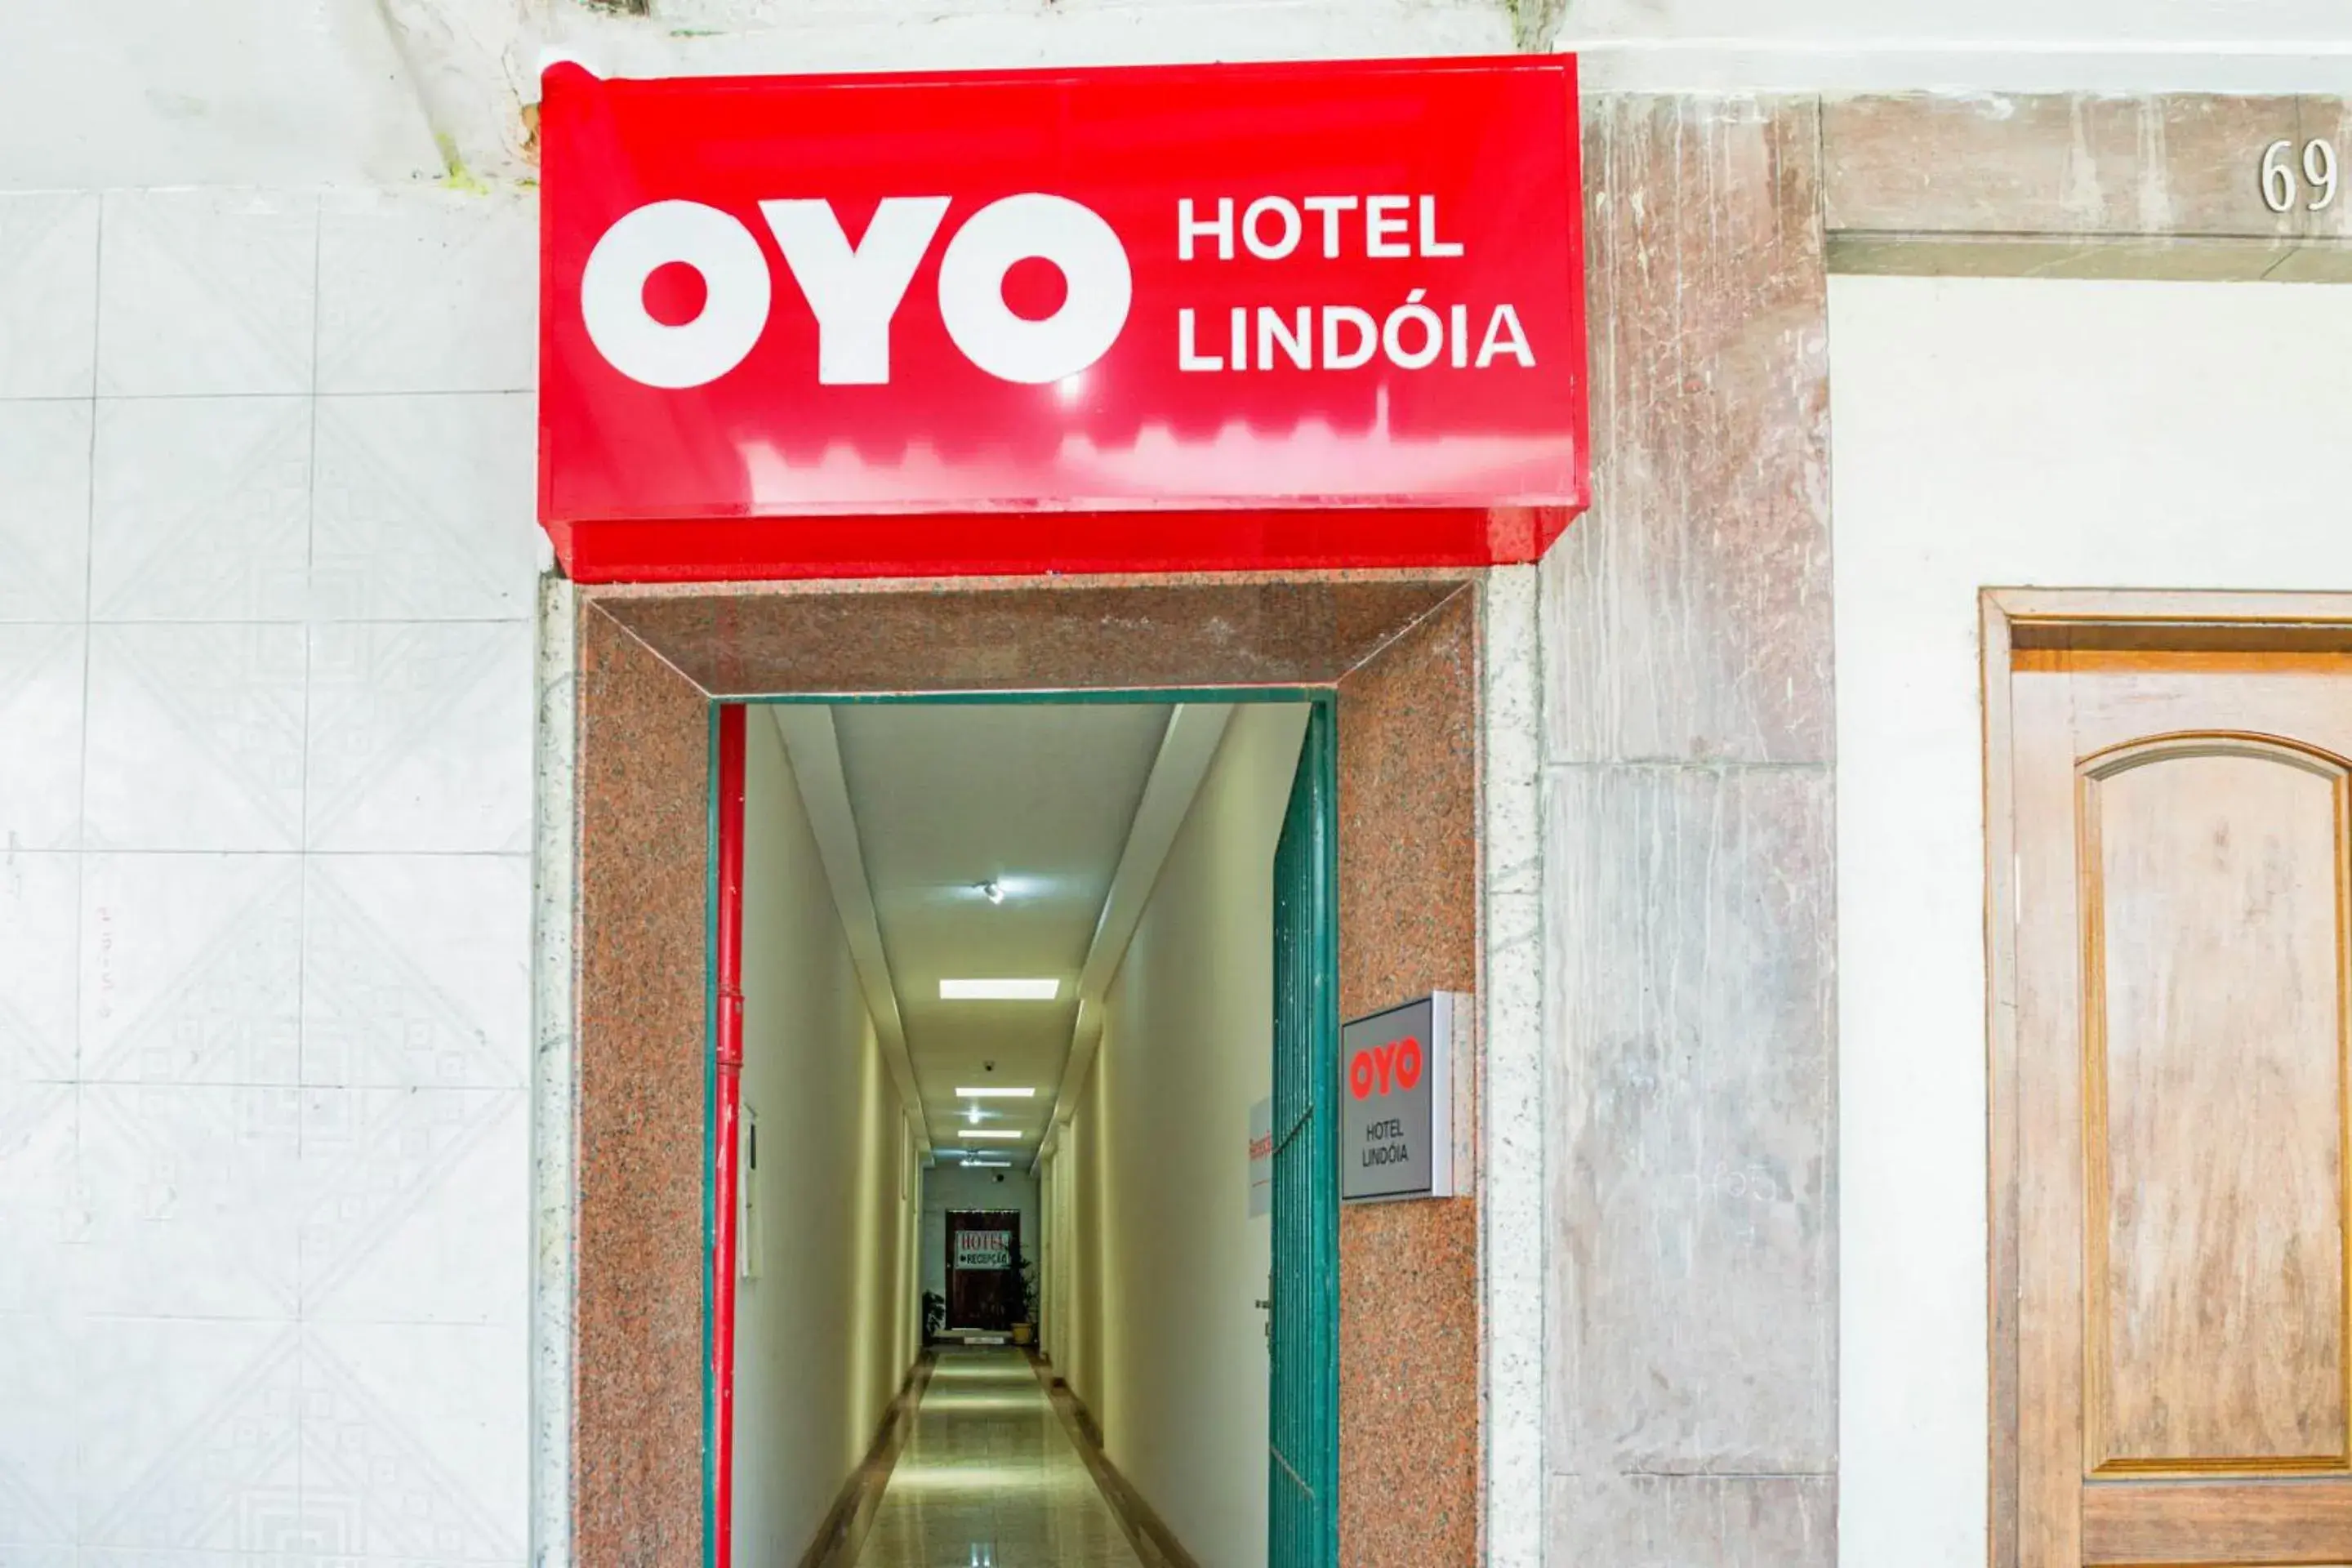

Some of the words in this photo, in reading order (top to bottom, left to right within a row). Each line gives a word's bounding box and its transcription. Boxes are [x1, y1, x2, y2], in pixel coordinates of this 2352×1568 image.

[2261, 138, 2338, 212] 69
[1178, 195, 1464, 261] HOTEL
[581, 193, 1133, 389] OYO
[1178, 288, 1536, 371] LINDÓIA
[1349, 1035, 1423, 1101] OYO
[1362, 1143, 1410, 1168] LINDÓIA
[1365, 1118, 1405, 1141] HOTEL
[961, 1232, 1009, 1250] HOTEL
